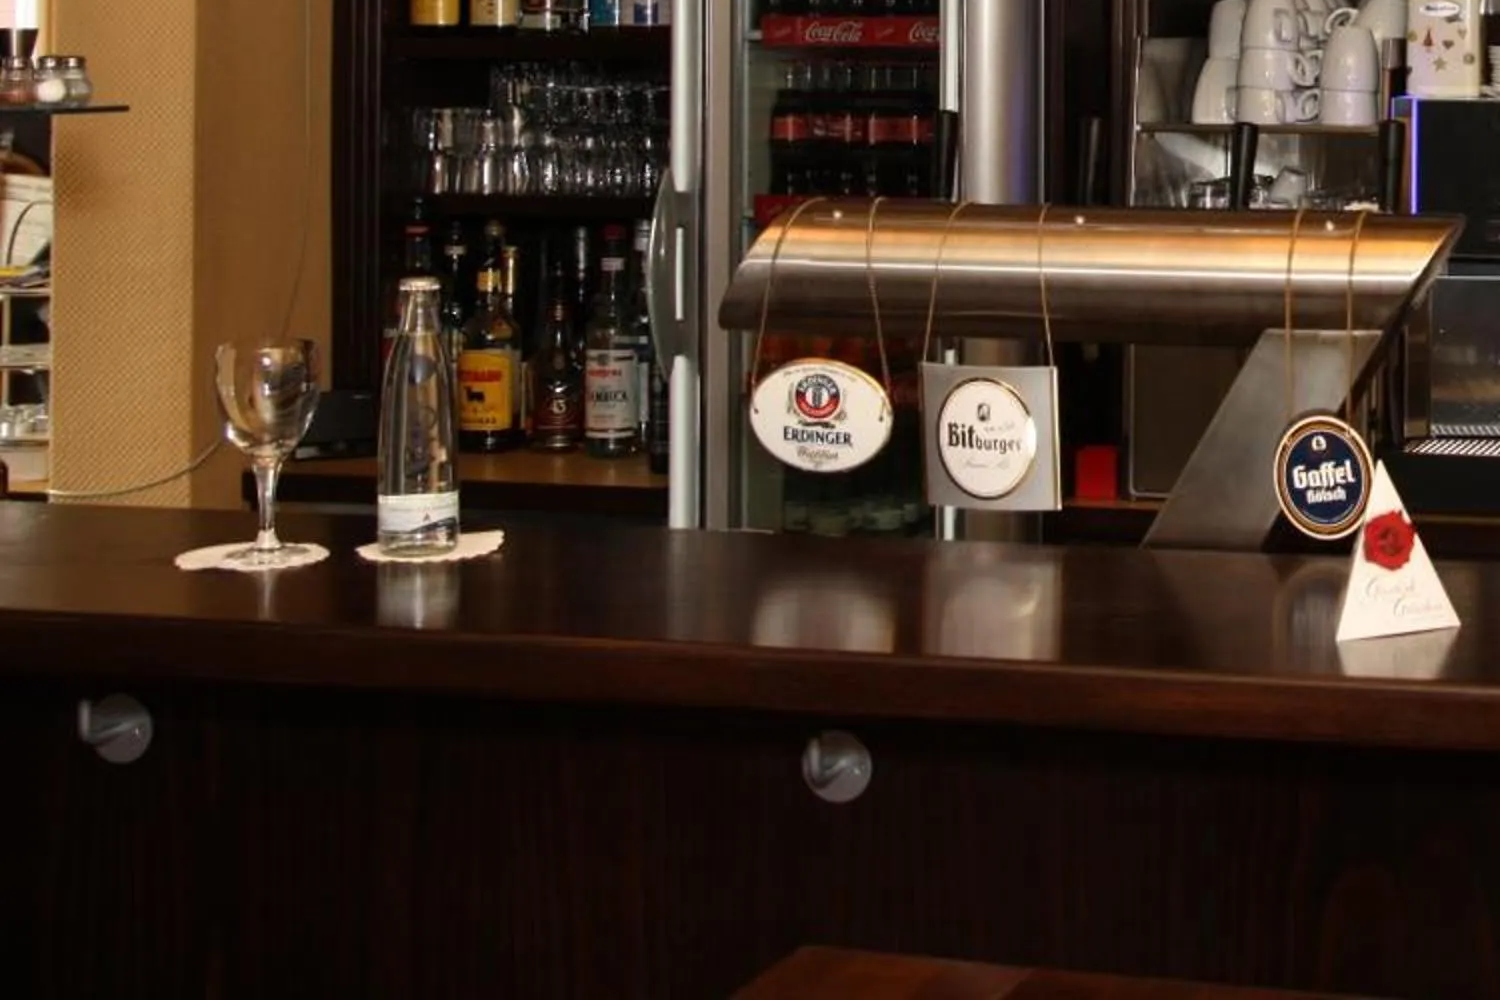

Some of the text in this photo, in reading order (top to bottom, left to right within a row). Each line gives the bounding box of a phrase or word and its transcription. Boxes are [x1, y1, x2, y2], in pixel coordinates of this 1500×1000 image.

[805, 21, 864, 43] Coca-Cola
[783, 426, 853, 449] ERDINGER
[947, 421, 1022, 455] Bitburger
[1293, 459, 1356, 489] Gaffel
